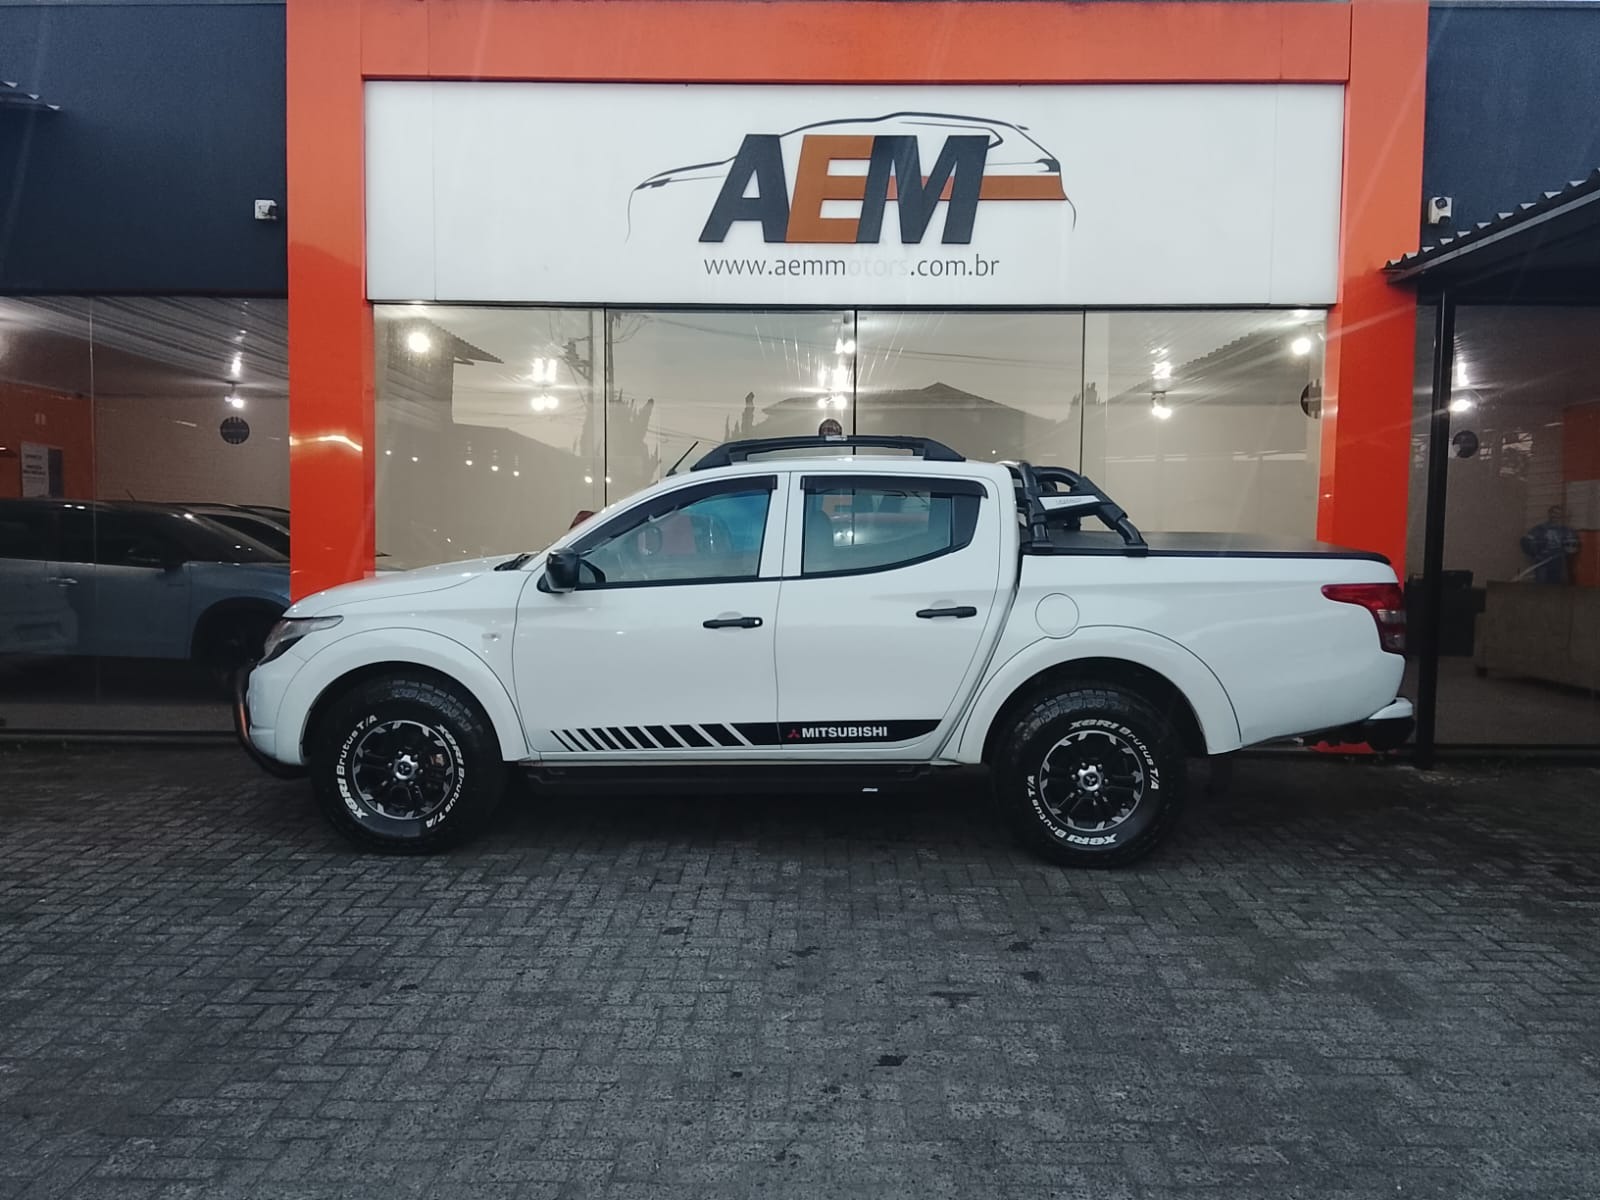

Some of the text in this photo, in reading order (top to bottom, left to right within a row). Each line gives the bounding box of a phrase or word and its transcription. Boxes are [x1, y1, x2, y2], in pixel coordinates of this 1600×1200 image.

[699, 134, 990, 244] AEM
[336, 731, 358, 776] Brutus
[357, 715, 378, 730] T/A
[802, 726, 888, 738] MITSUBISHI
[1118, 727, 1154, 766] Brutus
[445, 767, 465, 813] Brutus
[1032, 799, 1067, 838] Brutus
